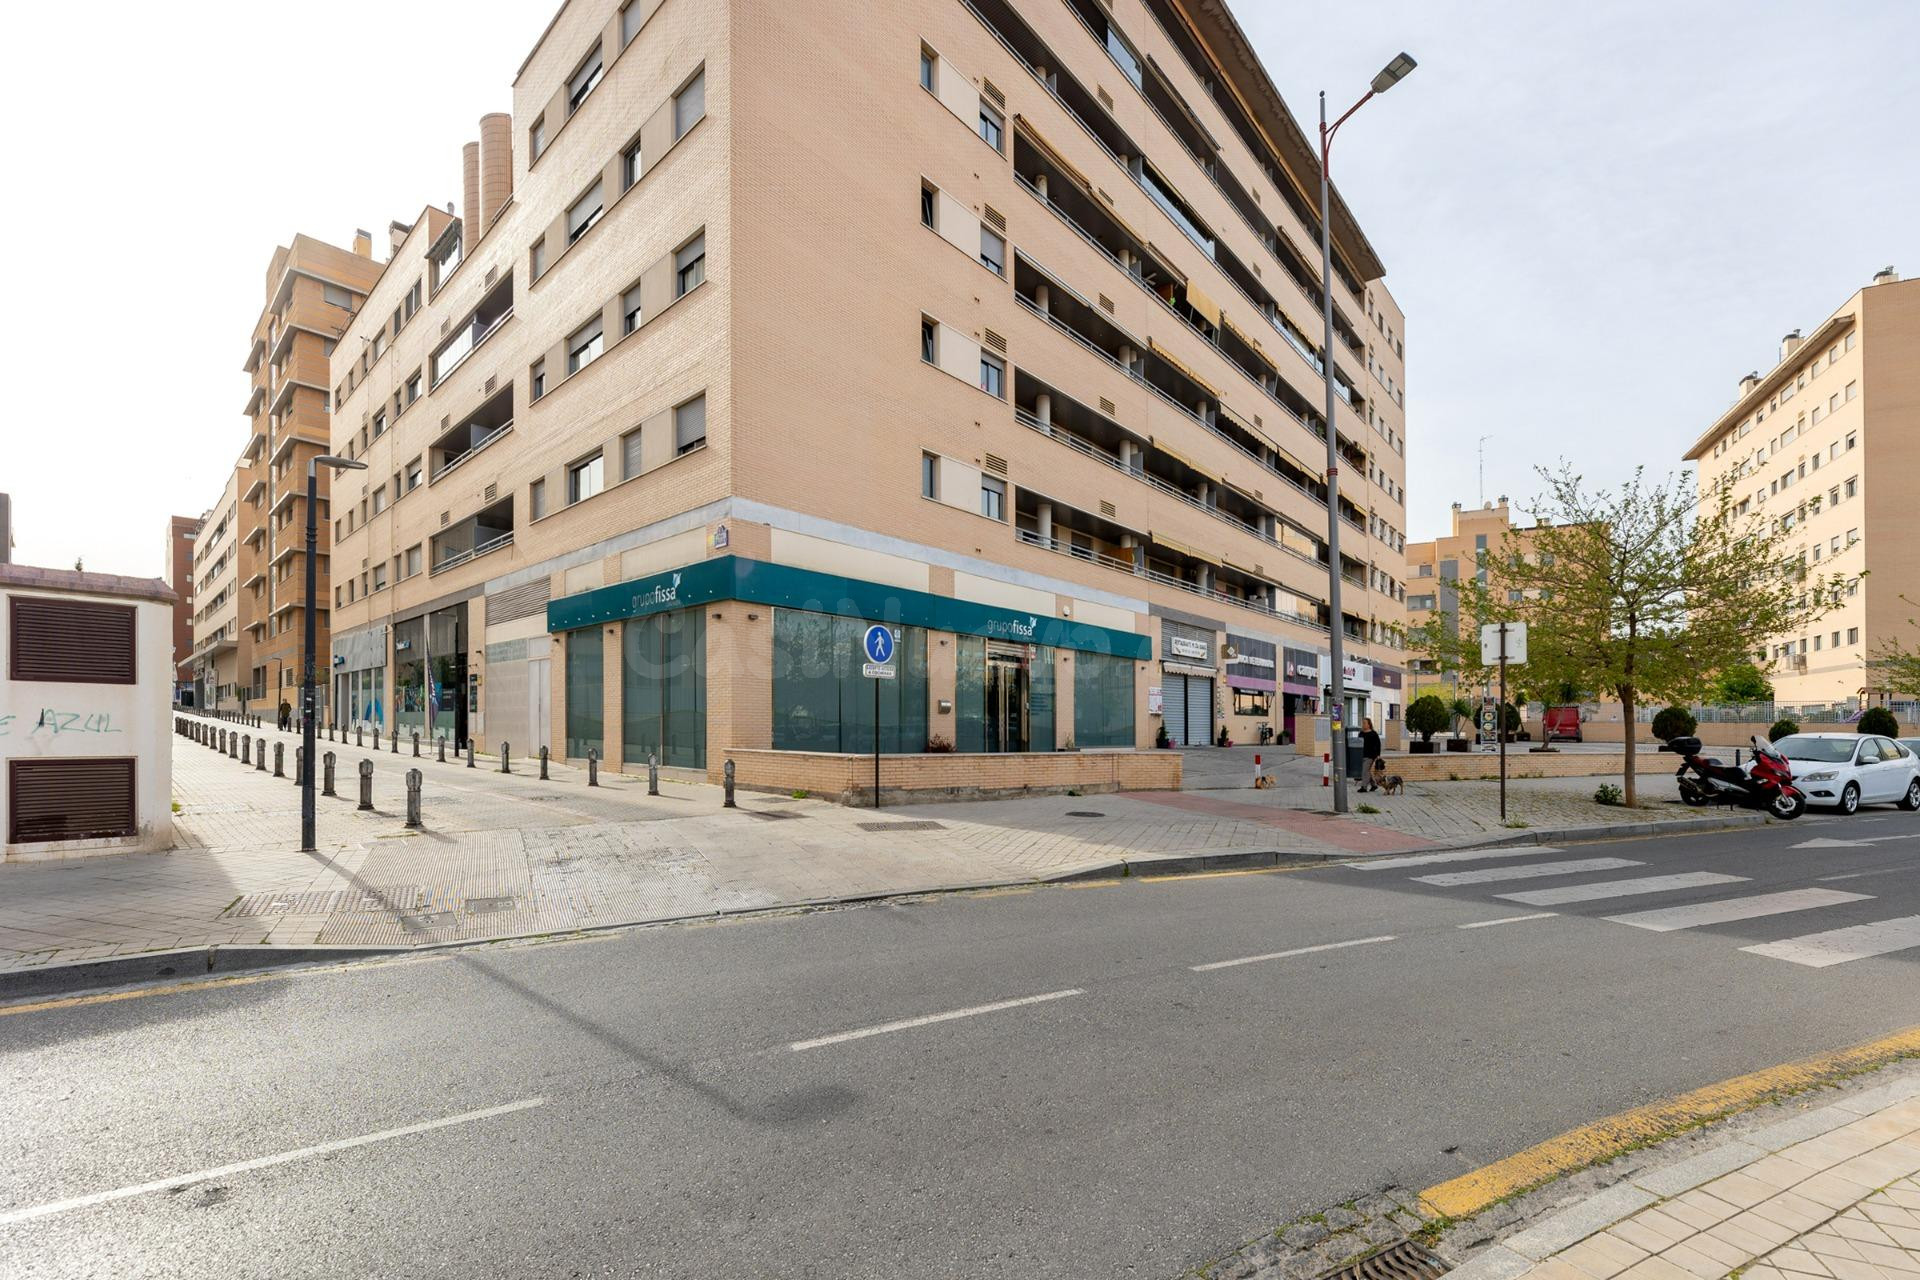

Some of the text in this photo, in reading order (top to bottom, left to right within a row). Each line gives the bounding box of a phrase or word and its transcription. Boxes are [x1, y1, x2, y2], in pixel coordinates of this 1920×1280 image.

[631, 584, 676, 609] grupofissa
[987, 619, 1033, 637] grupofissa
[31, 708, 123, 734] AZUL
